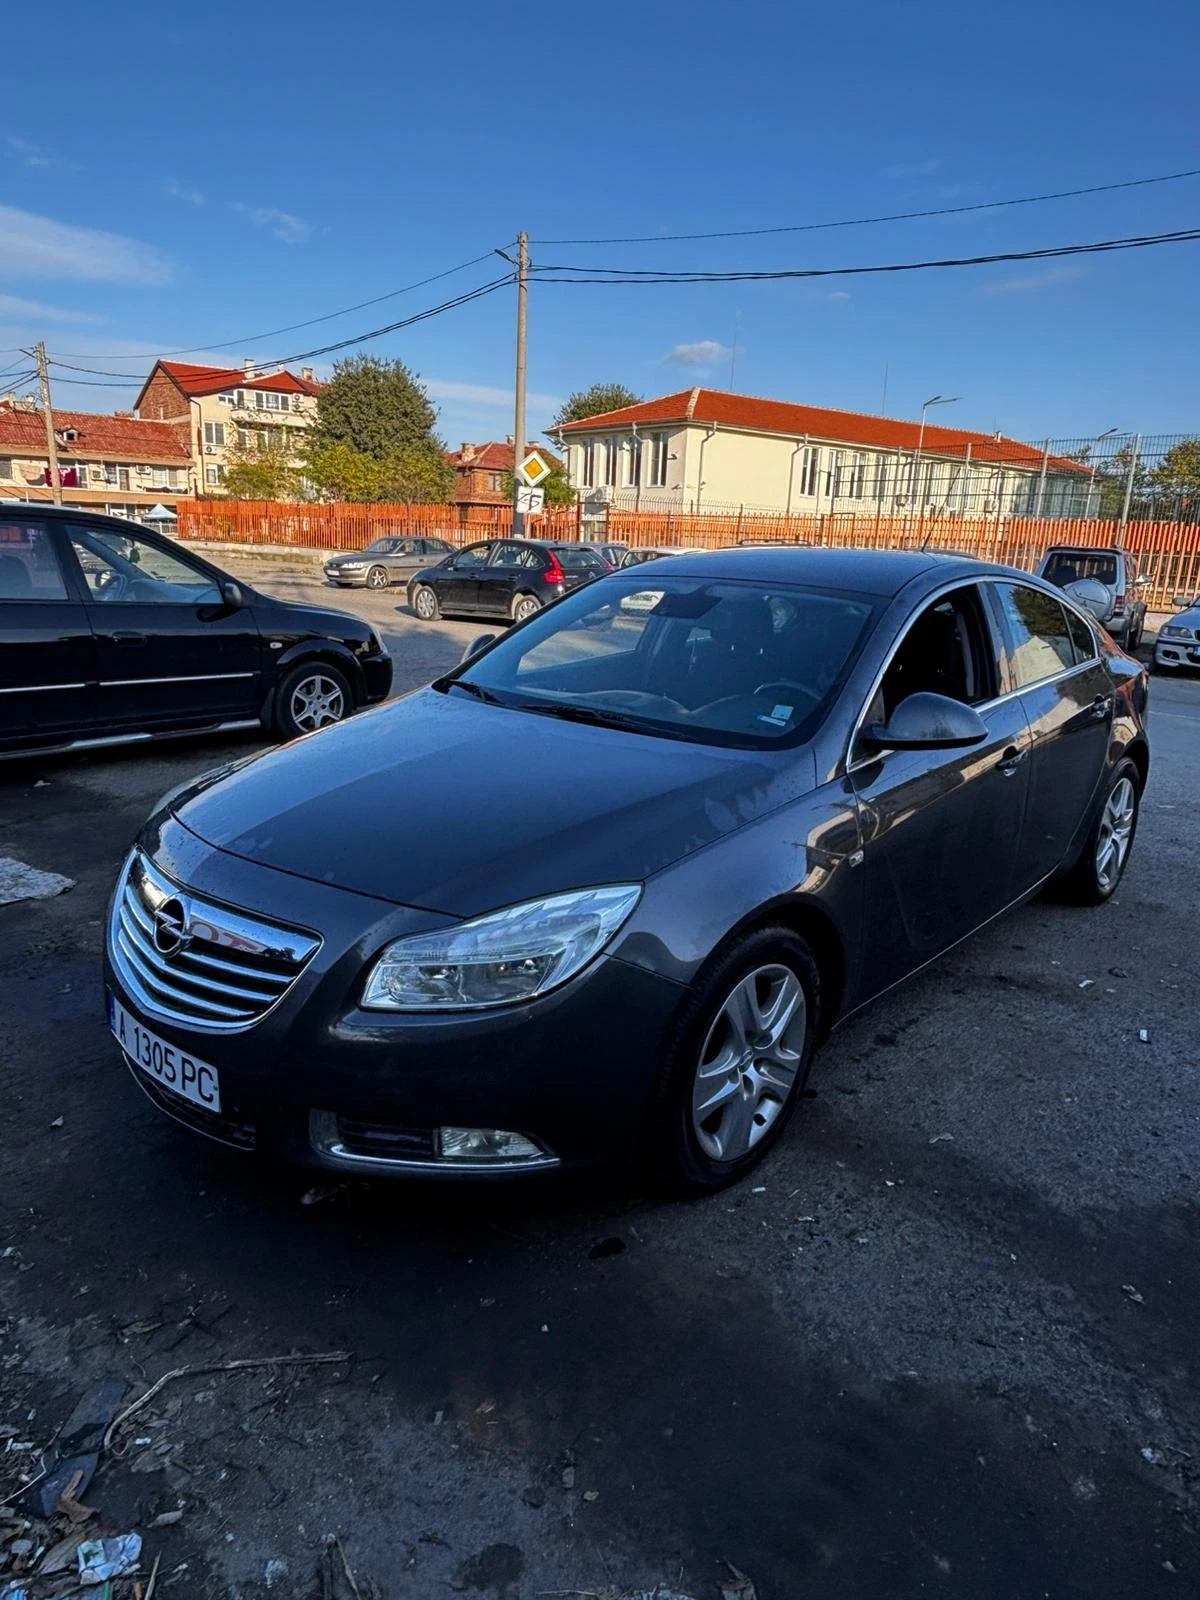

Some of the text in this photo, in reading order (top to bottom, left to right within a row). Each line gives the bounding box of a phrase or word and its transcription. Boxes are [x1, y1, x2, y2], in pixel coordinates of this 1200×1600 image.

[120, 1011, 214, 1103] A 1305 PC
